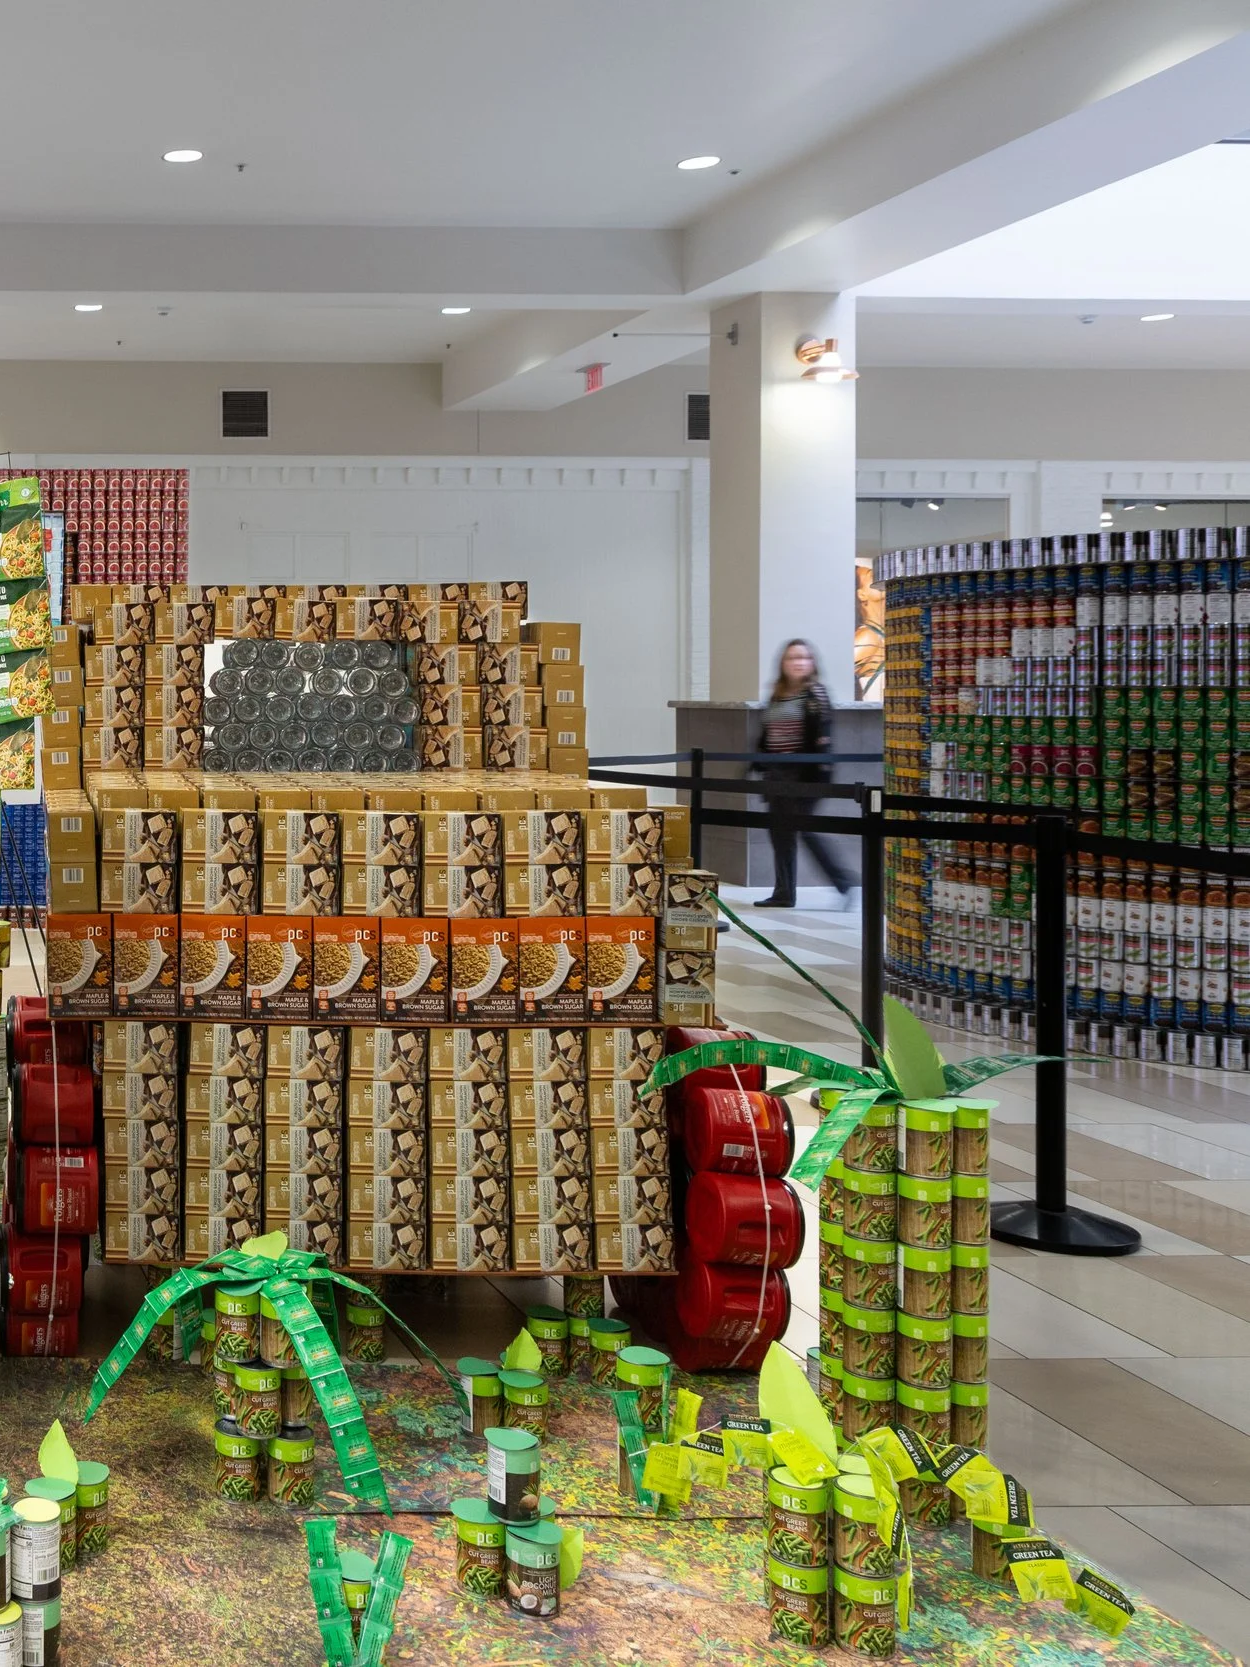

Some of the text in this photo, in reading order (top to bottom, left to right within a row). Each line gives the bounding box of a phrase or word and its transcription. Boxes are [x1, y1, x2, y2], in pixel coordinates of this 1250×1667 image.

[38, 1284, 48, 1308] Folgers
[227, 1301, 248, 1314] pics
[34, 1327, 44, 1353] Folgers
[727, 1421, 764, 1431] GREEN TEA
[711, 1445, 723, 1454] TEA
[898, 1429, 923, 1467] GREEN TEA
[941, 1452, 971, 1478] GREEN TEA
[782, 1494, 808, 1511] pics
[774, 1513, 808, 1528] CUT GREEN
[786, 1522, 808, 1533] BEANS
[477, 1531, 499, 1546] pics
[478, 1552, 499, 1561] GREEN
[536, 1551, 557, 1568] pics
[1013, 1550, 1056, 1560] GREEN TEA
[782, 1574, 808, 1591] pics
[774, 1592, 808, 1607] CUT GREEN
[1084, 1580, 1127, 1609] GREEN TEA
[786, 1602, 808, 1613] BEANS
